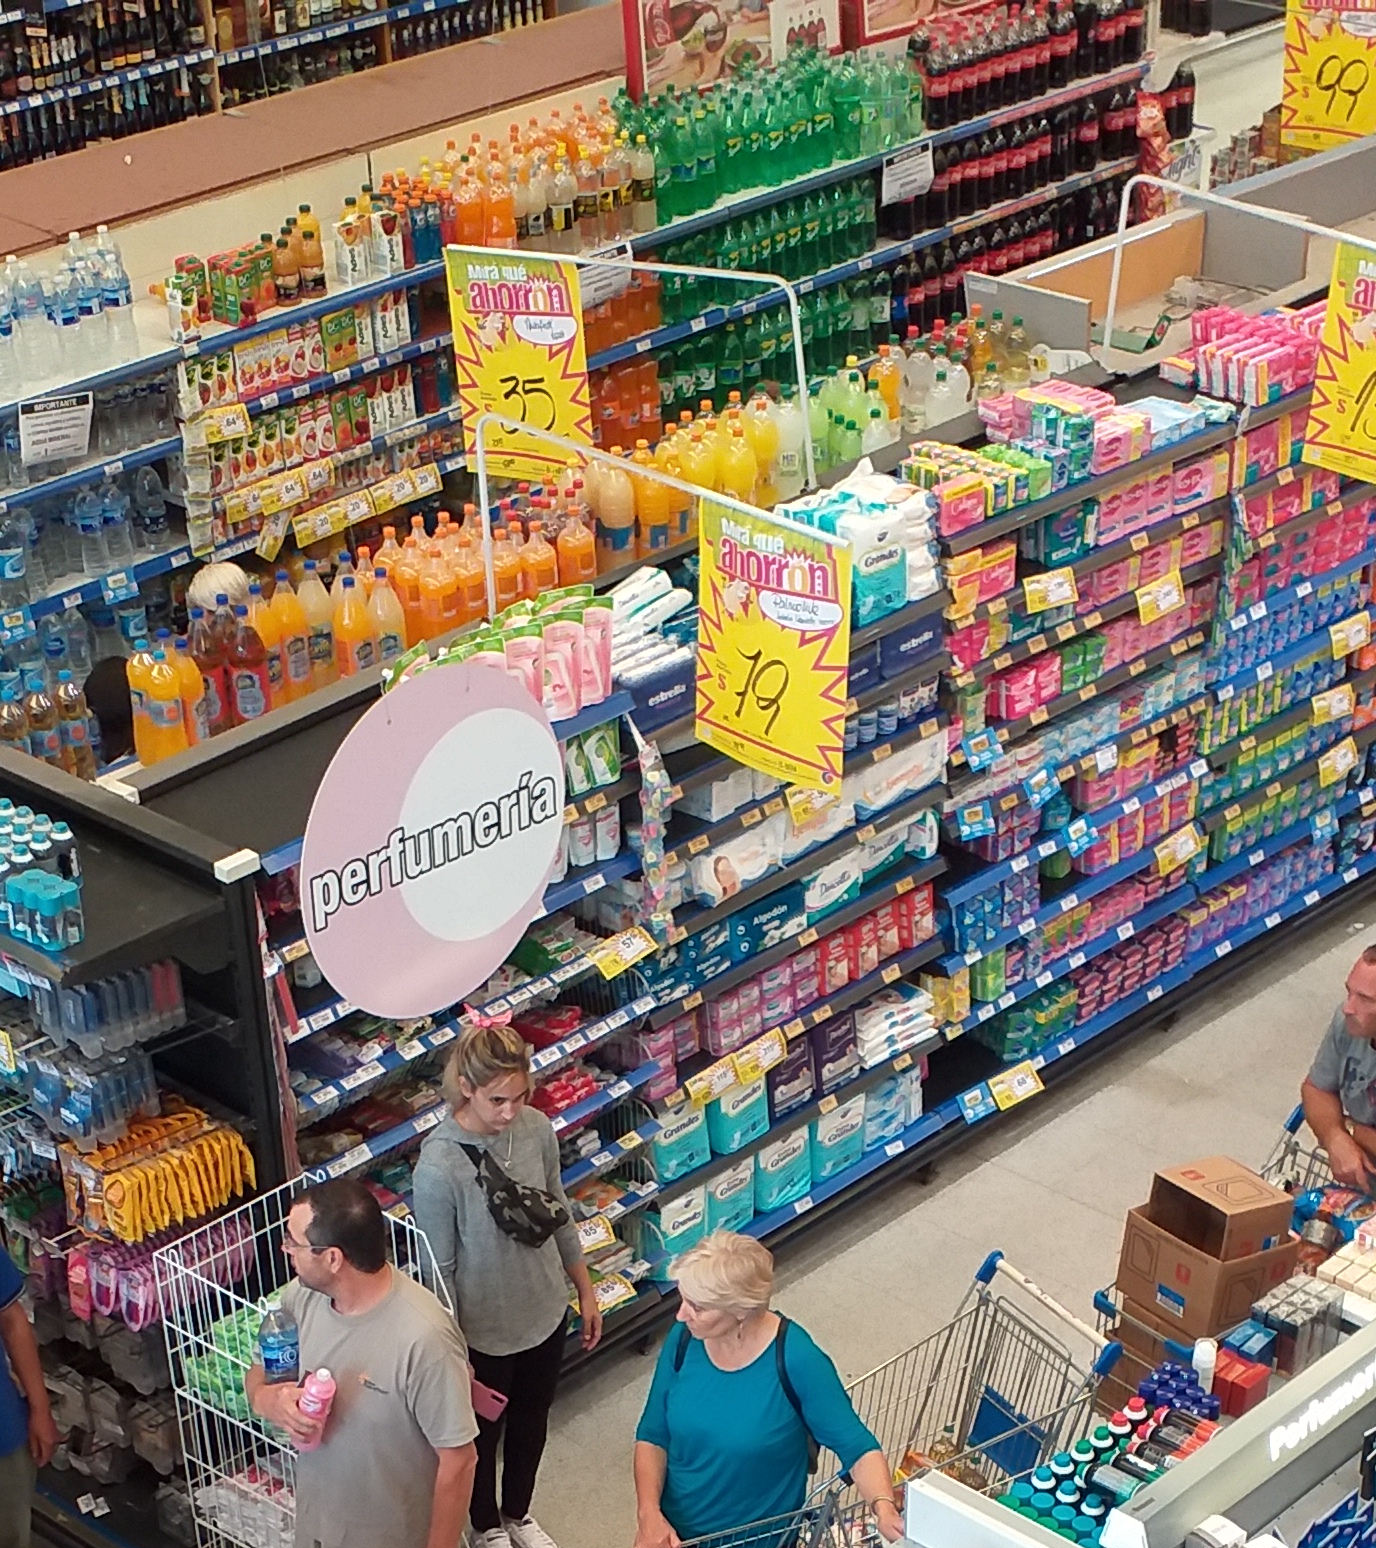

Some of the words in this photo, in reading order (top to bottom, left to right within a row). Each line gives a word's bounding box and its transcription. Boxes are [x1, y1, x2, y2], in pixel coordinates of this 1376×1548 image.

[1315, 54, 1370, 122] 99
[499, 375, 557, 435] 35
[899, 630, 935, 653] estrella
[648, 683, 687, 706] estrella
[308, 770, 558, 932] perfumería
[752, 903, 789, 926] Algodón
[663, 1112, 701, 1140] Grandes
